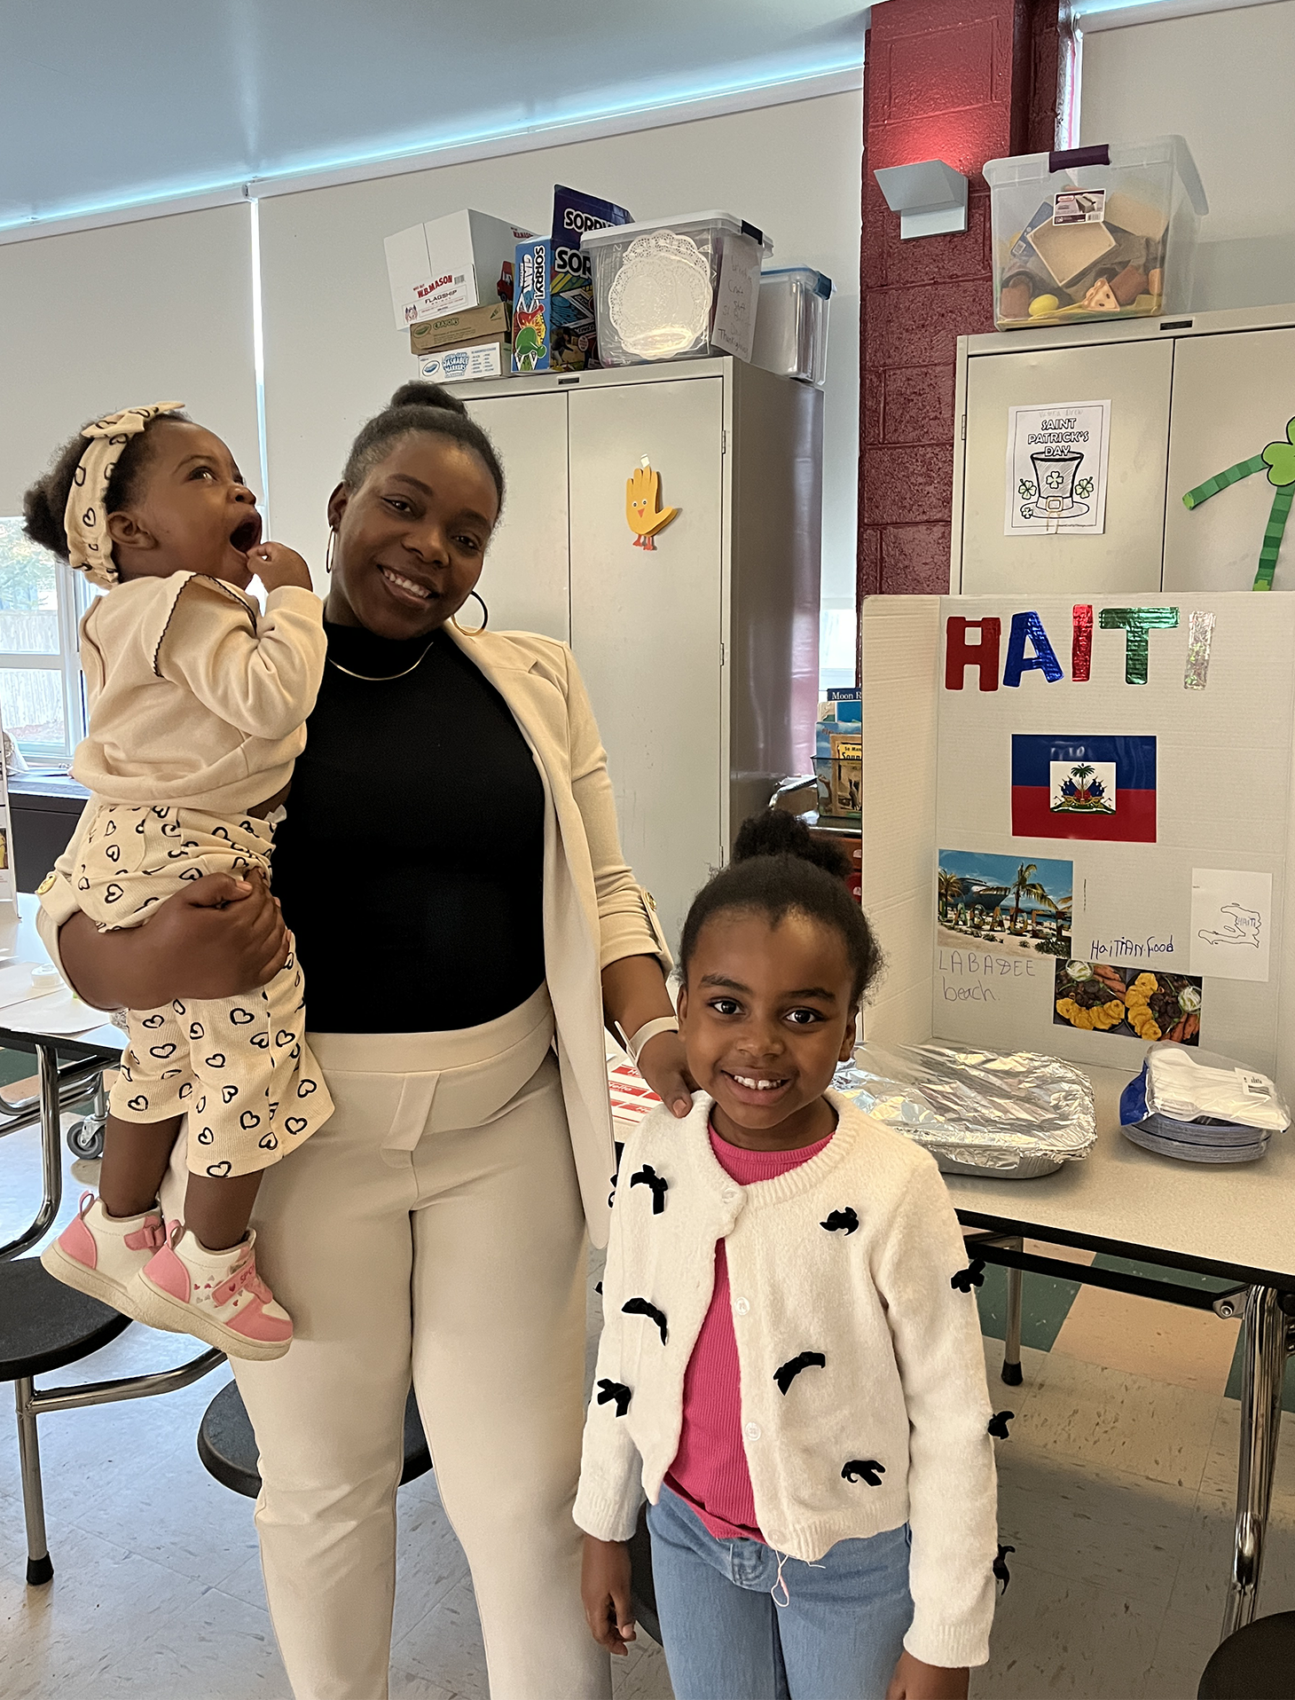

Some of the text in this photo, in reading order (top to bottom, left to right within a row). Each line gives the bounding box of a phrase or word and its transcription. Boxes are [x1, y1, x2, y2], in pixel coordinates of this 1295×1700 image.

[564, 208, 615, 232] SORR
[534, 245, 545, 299] SORRY!
[425, 290, 457, 304] FLAGSHIP
[1041, 418, 1077, 431] SAINT
[1028, 431, 1089, 445] PATRICK'S
[1045, 445, 1071, 457] DAY
[945, 604, 1216, 692] HAITI
[832, 692, 854, 700] Moon
[943, 976, 996, 1001] beach
